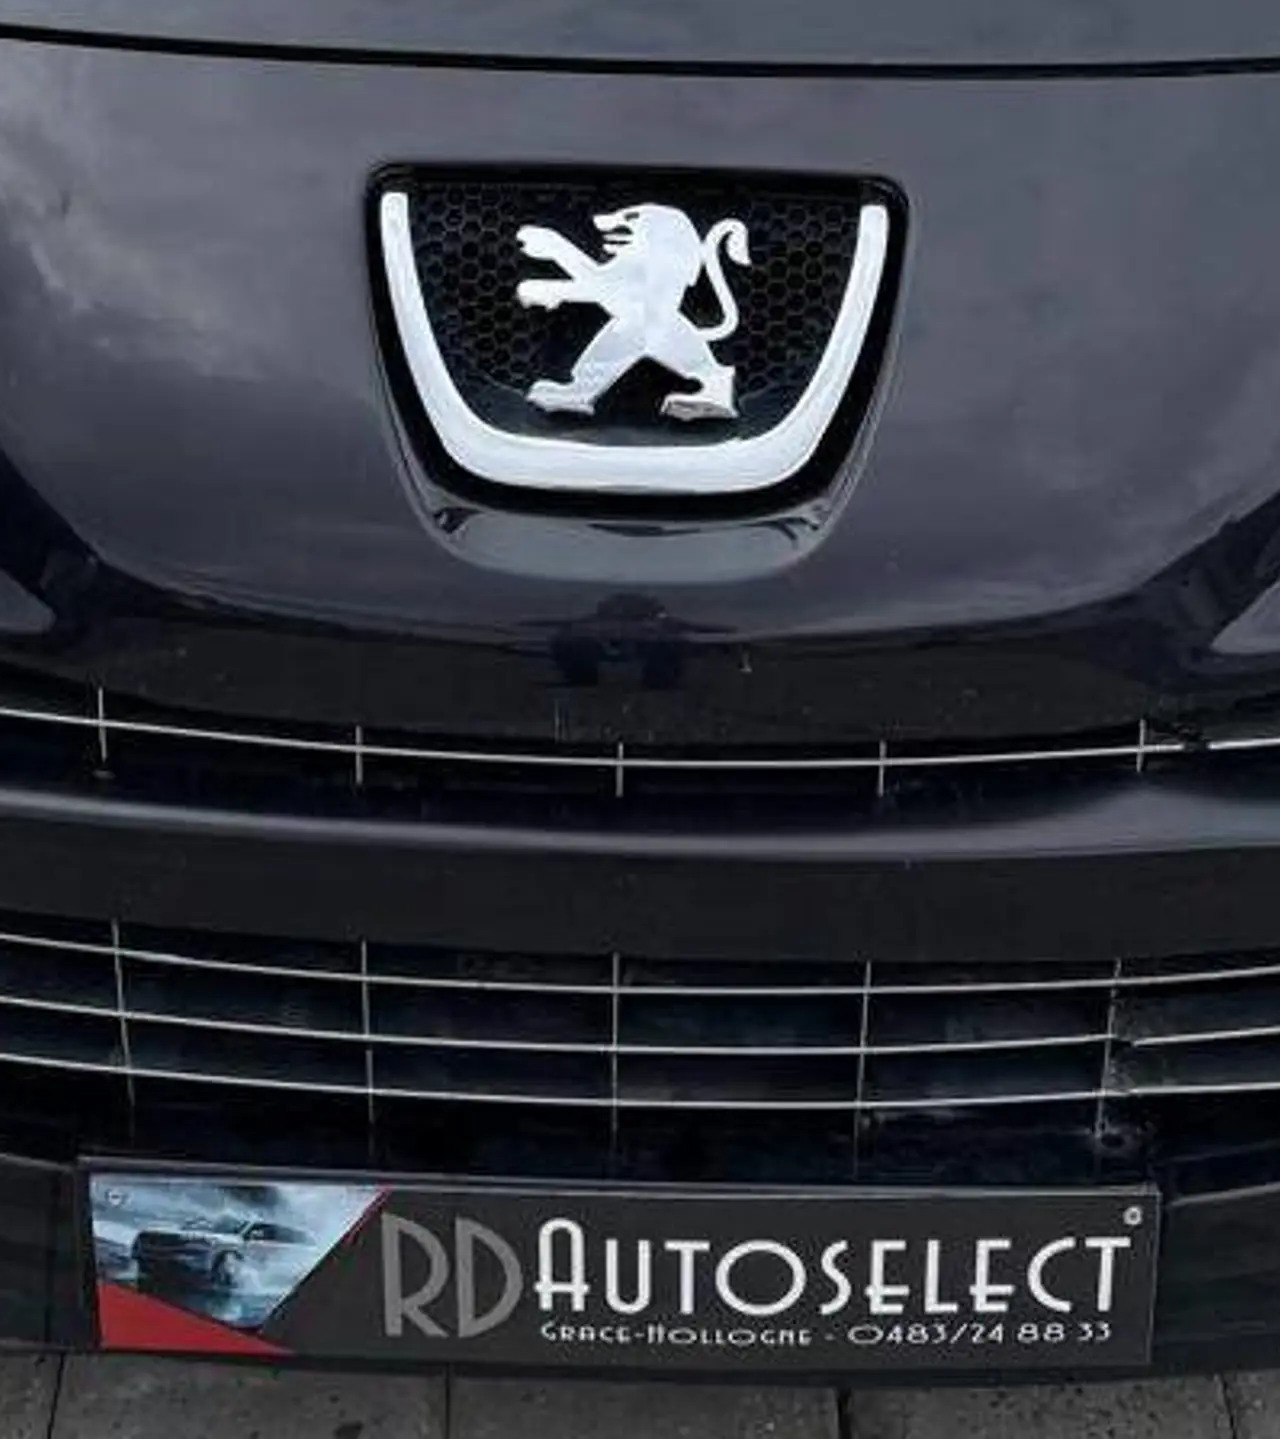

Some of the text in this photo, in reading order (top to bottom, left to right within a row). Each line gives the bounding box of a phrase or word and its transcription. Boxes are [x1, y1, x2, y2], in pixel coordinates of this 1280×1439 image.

[846, 1321, 1005, 1346] 0483/24
[1016, 1321, 1067, 1344] 88
[1077, 1321, 1113, 1343] 33
